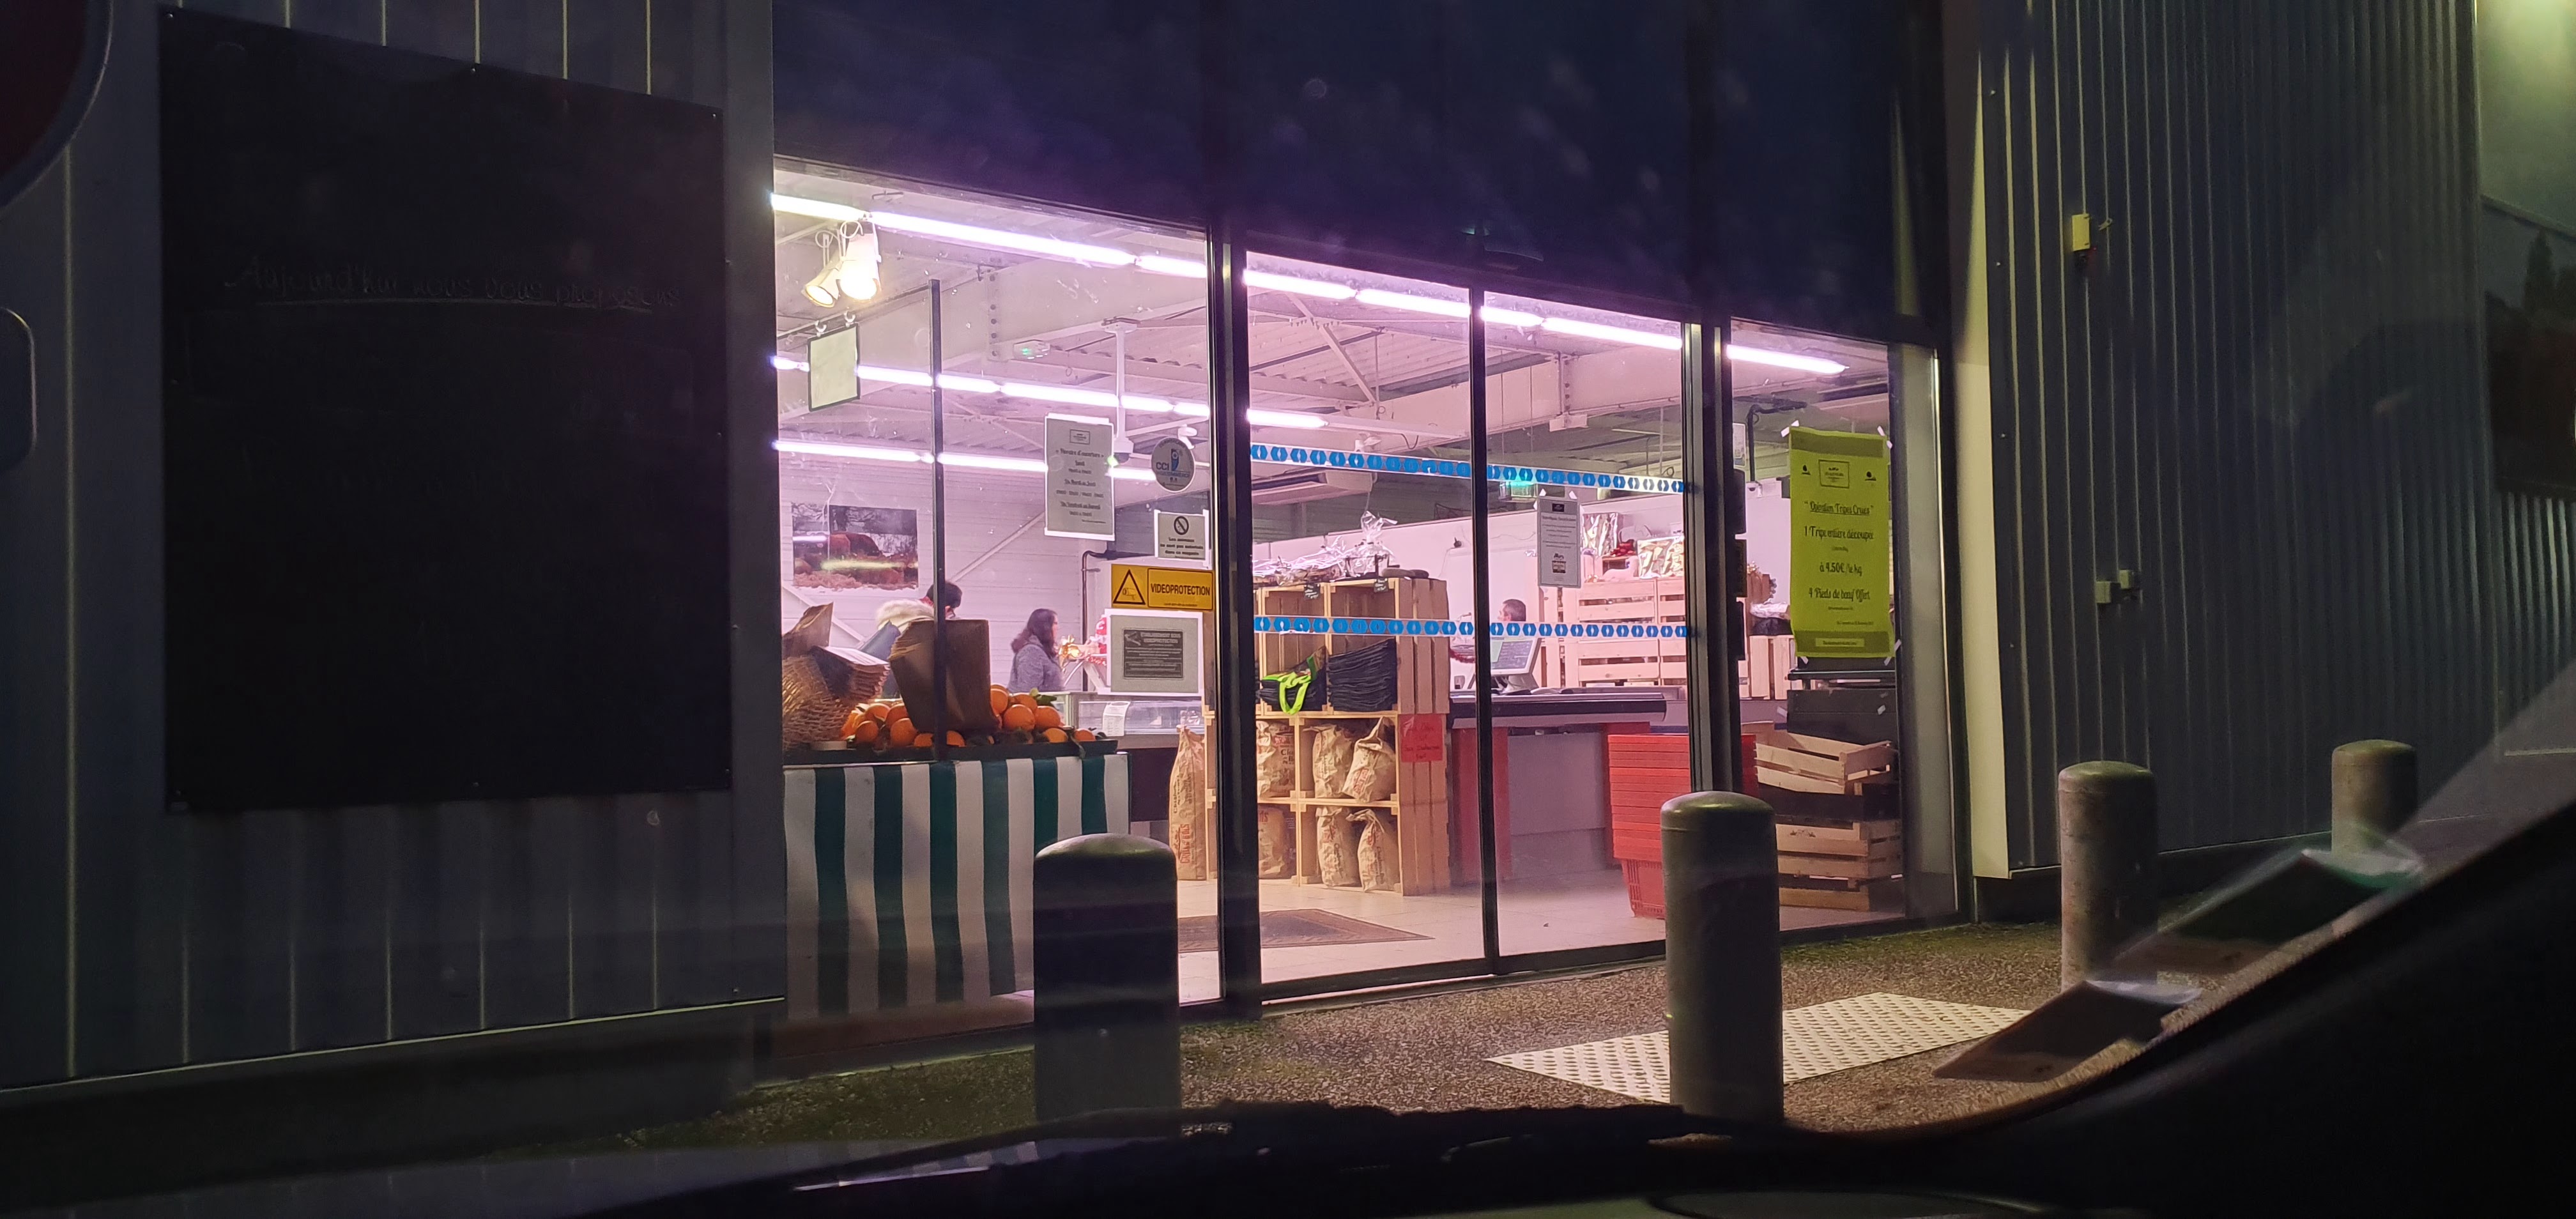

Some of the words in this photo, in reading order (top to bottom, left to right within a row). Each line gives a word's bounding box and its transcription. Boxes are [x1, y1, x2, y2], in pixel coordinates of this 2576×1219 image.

[1156, 462, 1169, 471] CCI
[1809, 526, 1827, 541] Tripe
[1150, 583, 1210, 595] VIDEOPROTECTION
[1814, 587, 1832, 599] Pieds
[1832, 588, 1840, 599] de
